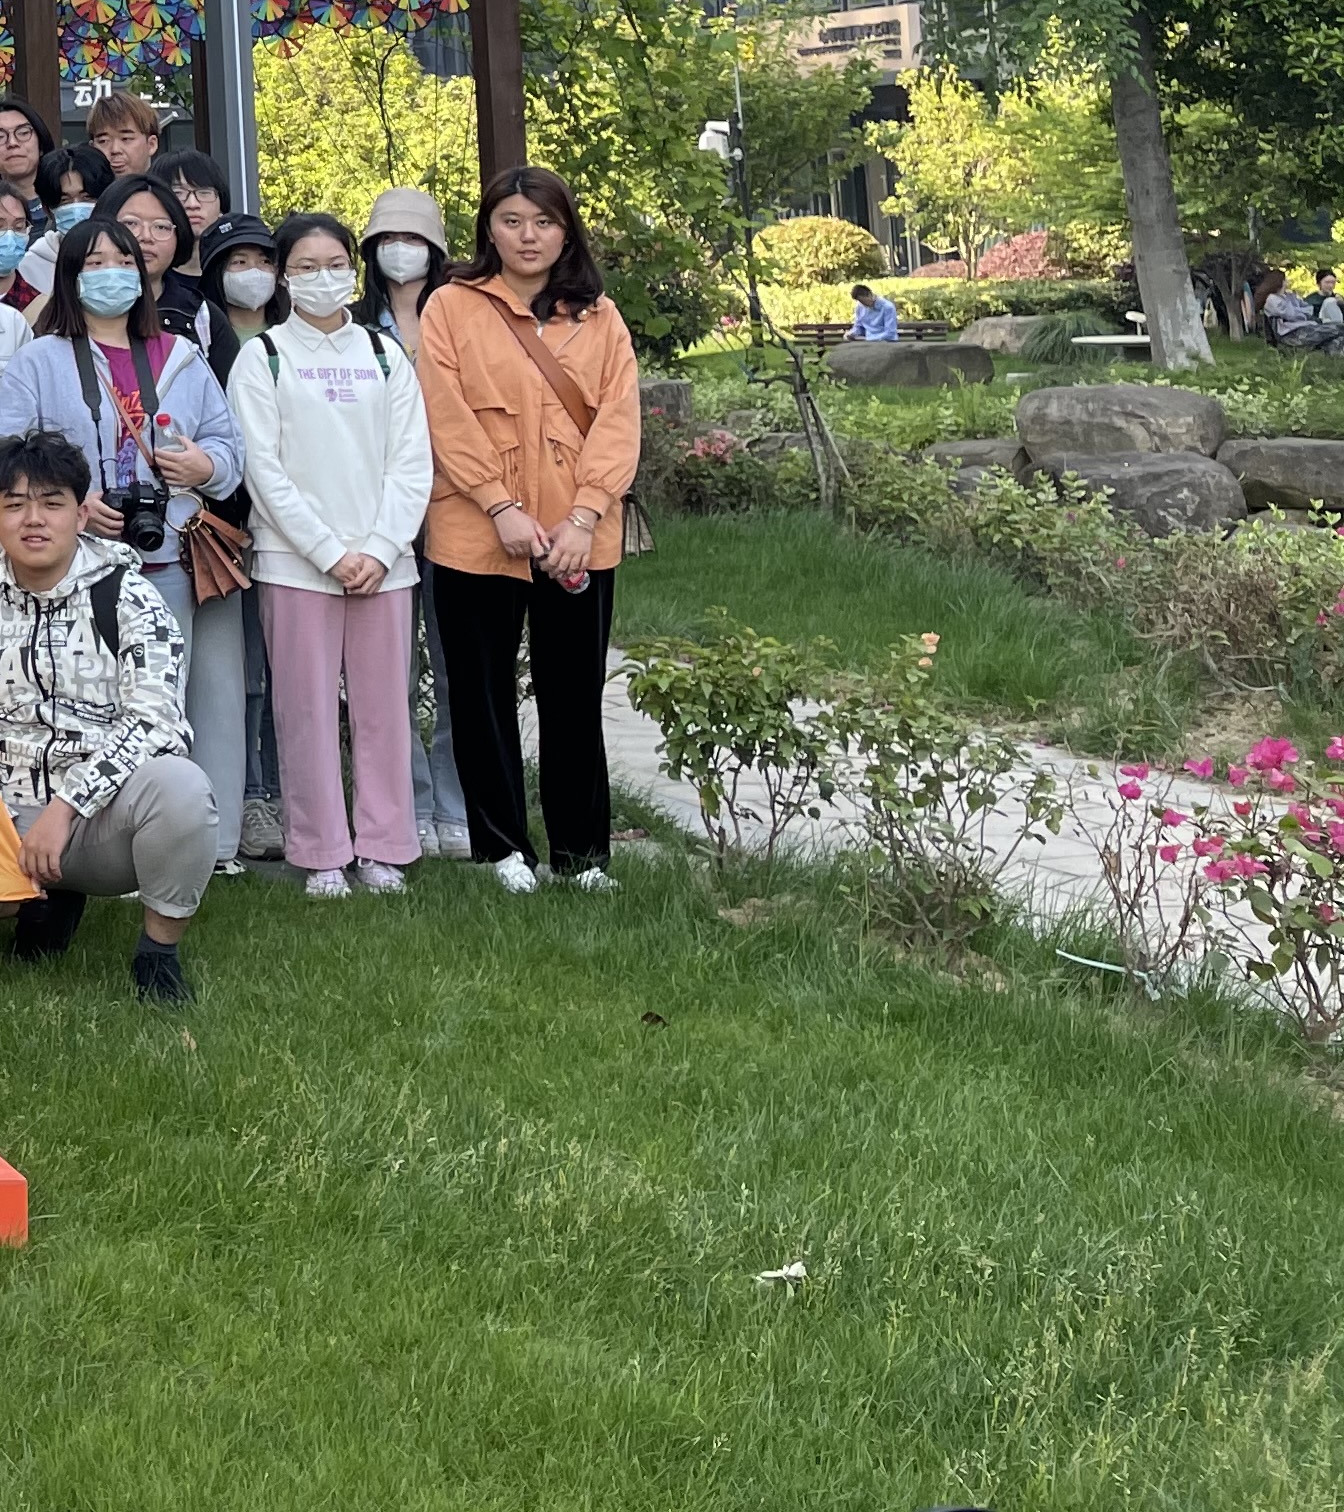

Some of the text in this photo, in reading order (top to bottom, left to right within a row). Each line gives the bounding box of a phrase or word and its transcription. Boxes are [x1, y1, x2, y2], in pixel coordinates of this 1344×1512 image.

[297, 368, 316, 380] THE
[317, 367, 338, 380] GIFT
[339, 367, 352, 380] OF
